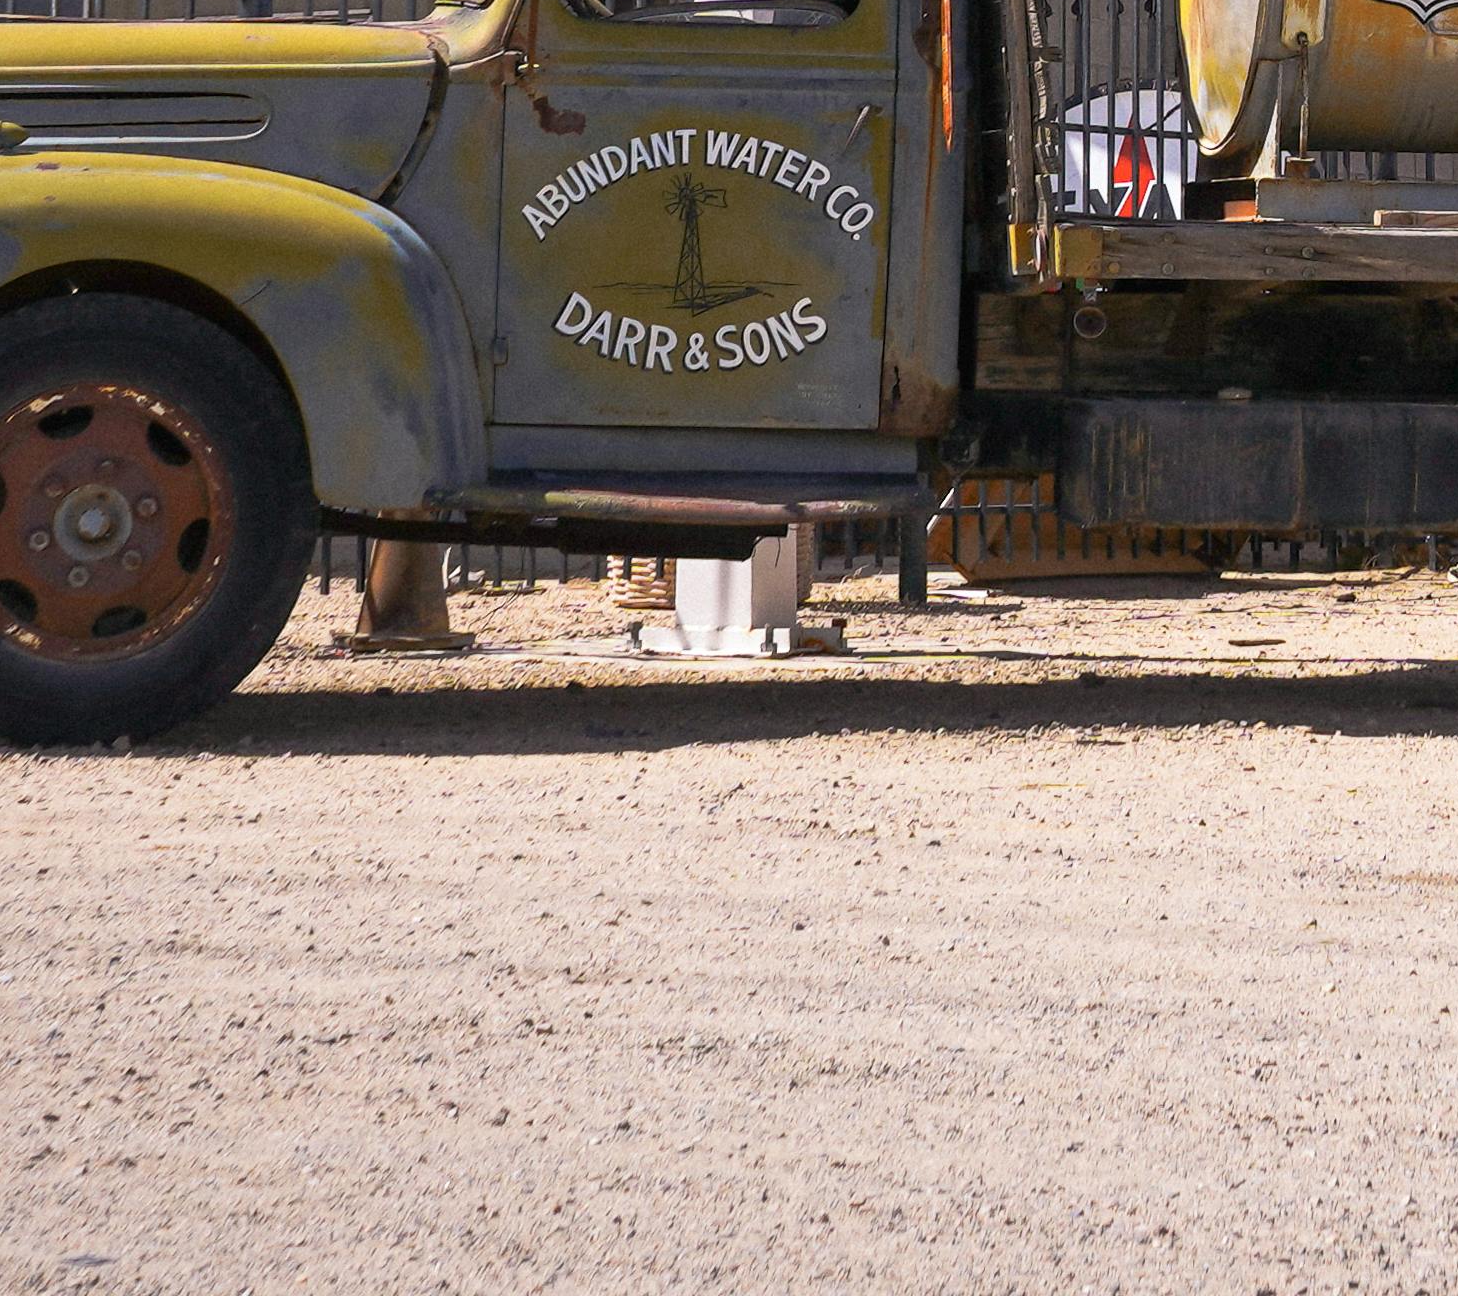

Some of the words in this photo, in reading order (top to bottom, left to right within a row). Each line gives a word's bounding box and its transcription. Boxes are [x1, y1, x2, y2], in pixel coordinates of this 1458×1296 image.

[521, 128, 697, 241] ABUNDANT
[706, 129, 831, 201] WATER
[825, 185, 875, 241] CO.
[553, 291, 678, 373] DARR
[684, 332, 711, 371] &
[714, 296, 828, 369] SONS
